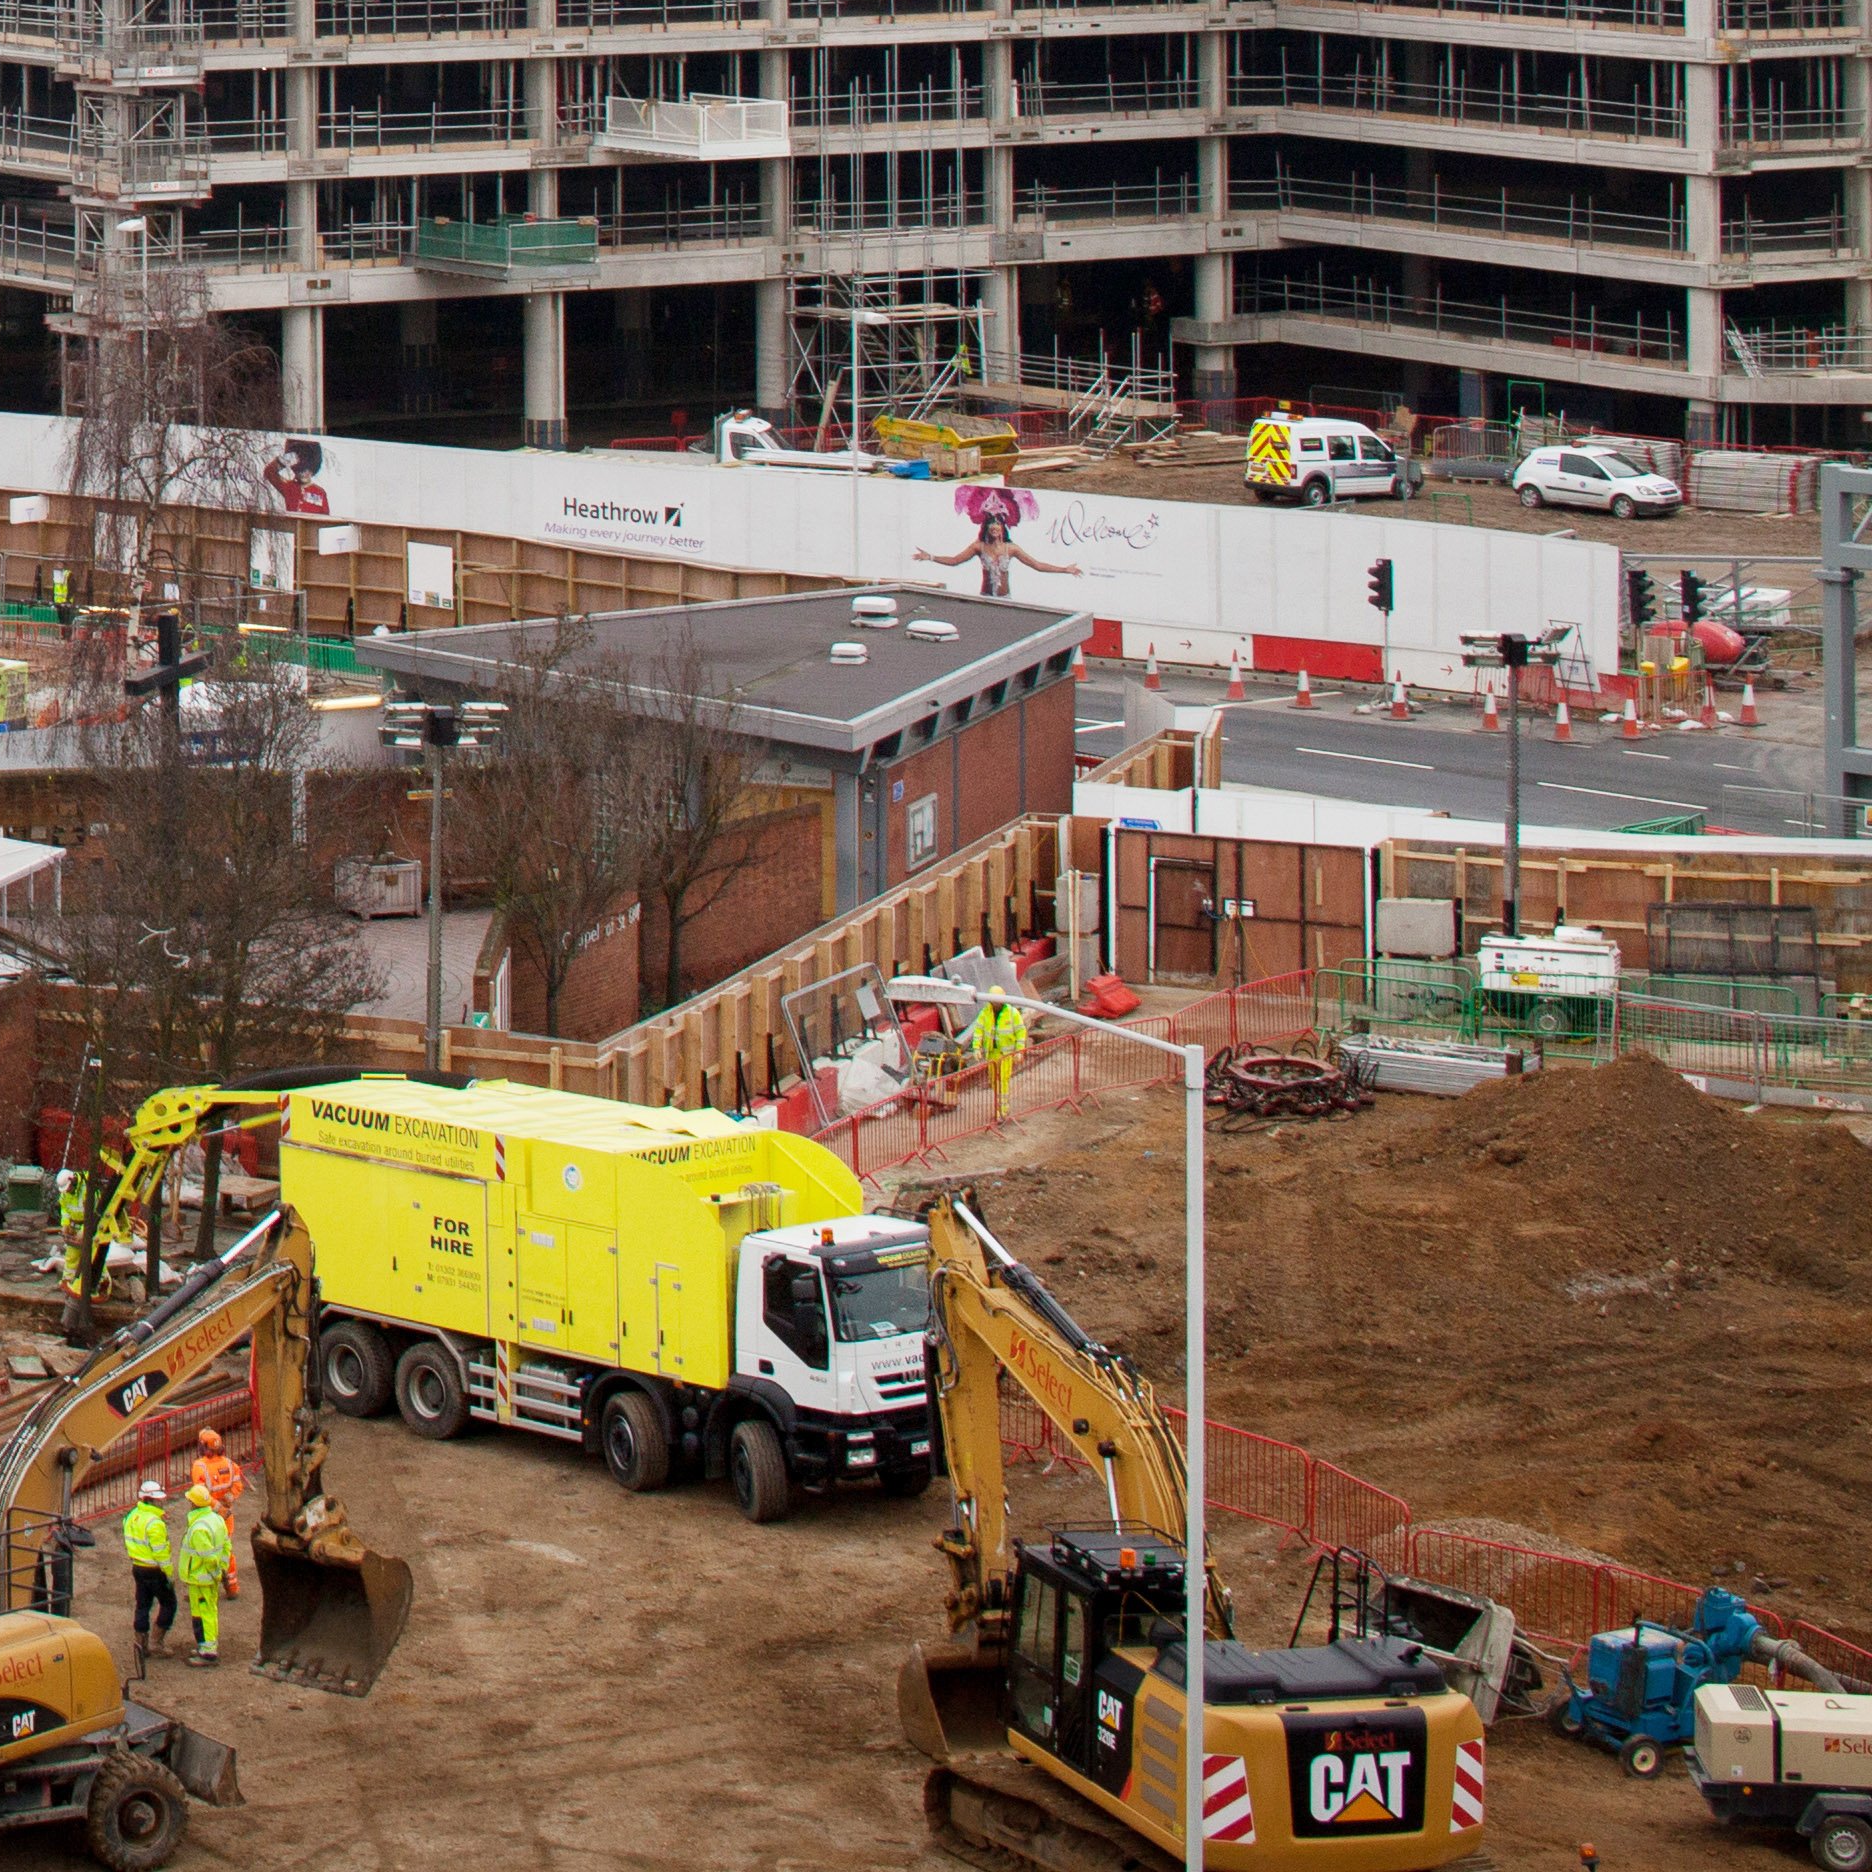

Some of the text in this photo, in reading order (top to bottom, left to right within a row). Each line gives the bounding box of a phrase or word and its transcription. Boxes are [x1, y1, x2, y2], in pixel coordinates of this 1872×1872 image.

[563, 496, 658, 524] Heathrow
[544, 522, 705, 549] Making every journey better
[312, 1100, 479, 1149] VACUUM EXCAVATION
[318, 1131, 336, 1146] Safe
[338, 1136, 382, 1154] excavation
[383, 1144, 413, 1160] around
[415, 1150, 442, 1167] buried
[444, 1158, 475, 1172] utilities
[694, 1136, 756, 1160] EXCAVATION
[433, 1216, 470, 1237] FOR
[430, 1235, 474, 1257] HIRE
[185, 1309, 235, 1362] Select
[122, 1374, 149, 1413] CAT
[1026, 1347, 1074, 1416] Select
[12, 1709, 36, 1739] CAT
[1098, 1689, 1123, 1731] CAT
[1097, 1725, 1117, 1750] 320E
[1345, 1730, 1395, 1749] Select
[1309, 1751, 1412, 1822] CAT
